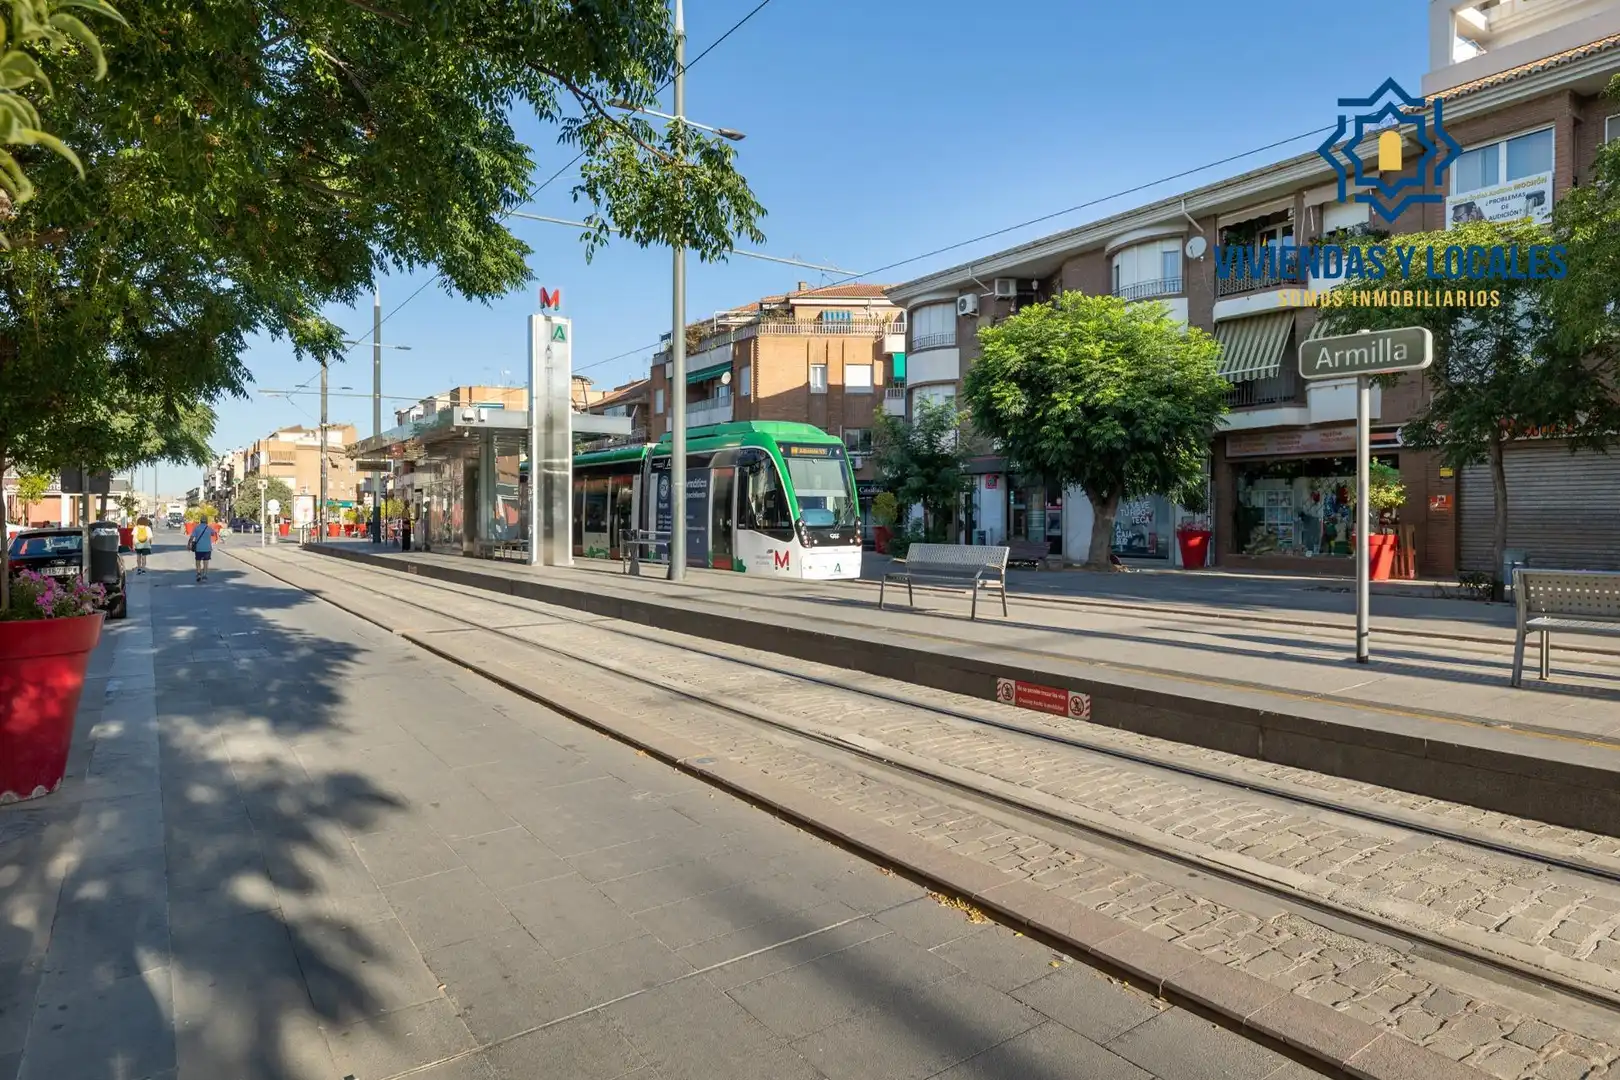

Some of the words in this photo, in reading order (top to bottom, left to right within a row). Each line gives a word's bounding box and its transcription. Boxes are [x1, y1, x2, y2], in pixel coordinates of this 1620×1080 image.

[1485, 192, 1526, 206] ¿PROBLEMAS
[1315, 337, 1408, 370] Armilla
[1131, 516, 1150, 524] TECA
